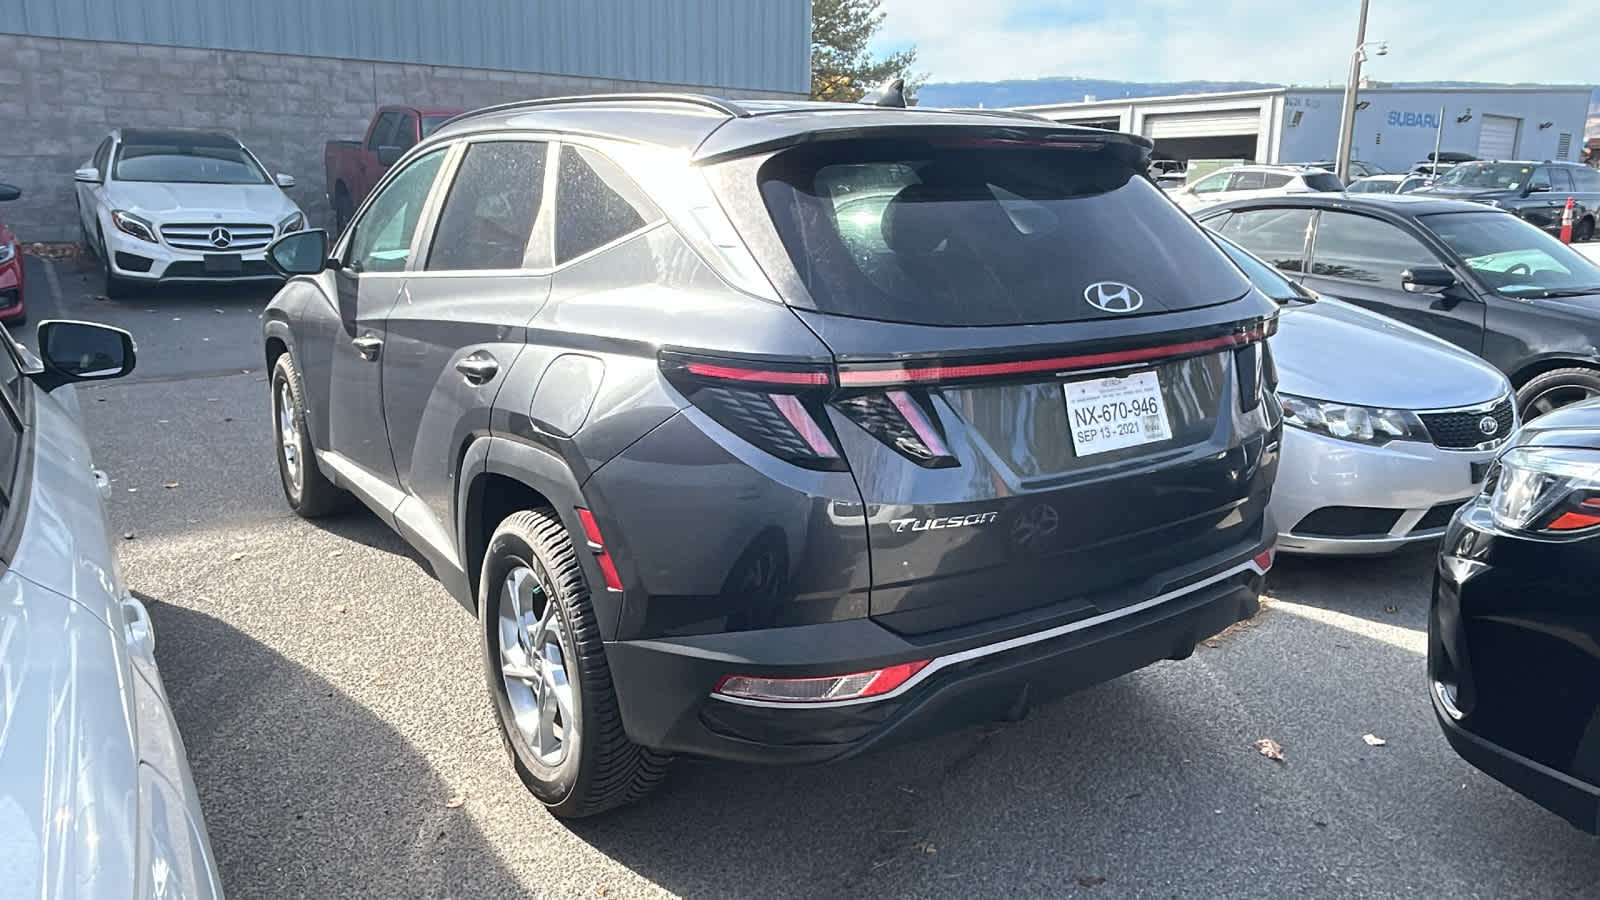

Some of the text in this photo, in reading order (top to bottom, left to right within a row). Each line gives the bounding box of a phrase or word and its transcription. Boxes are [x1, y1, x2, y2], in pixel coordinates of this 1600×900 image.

[1387, 111, 1441, 128] SUBARU
[1074, 397, 1158, 427] NX-670-946
[1077, 429, 1097, 443] SEP
[1119, 422, 1140, 436] 2021
